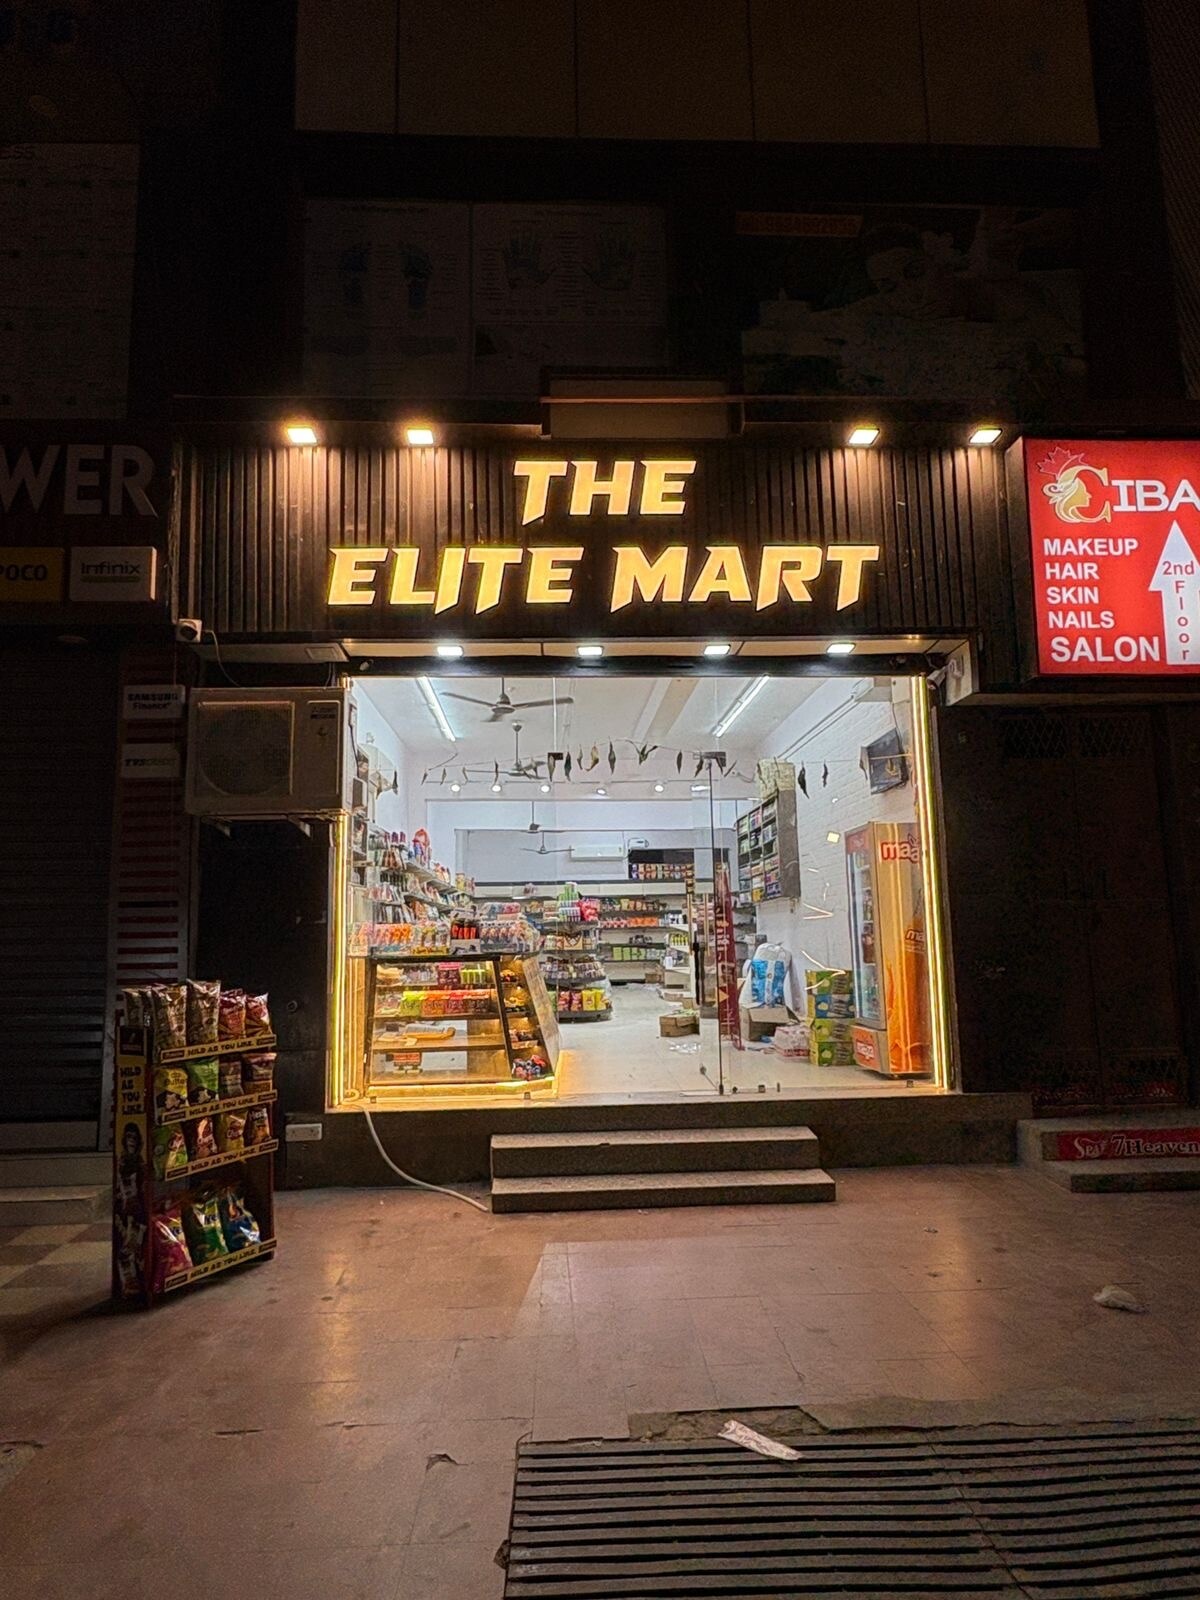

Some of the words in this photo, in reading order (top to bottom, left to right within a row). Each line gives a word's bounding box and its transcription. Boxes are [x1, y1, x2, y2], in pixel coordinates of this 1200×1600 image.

[0, 444, 157, 517] WER
[513, 459, 697, 526] THE
[1043, 464, 1200, 524] CIBA
[1043, 538, 1139, 556] MAKEUP
[81, 560, 140, 575] Infinix
[1045, 562, 1100, 580] HAIR
[1162, 561, 1195, 576] 2nd
[327, 545, 584, 614] ELITE
[611, 544, 880, 613] MART
[1046, 586, 1099, 604] SKIN
[1048, 610, 1115, 629] NAILS
[1050, 636, 1161, 662] SALON
